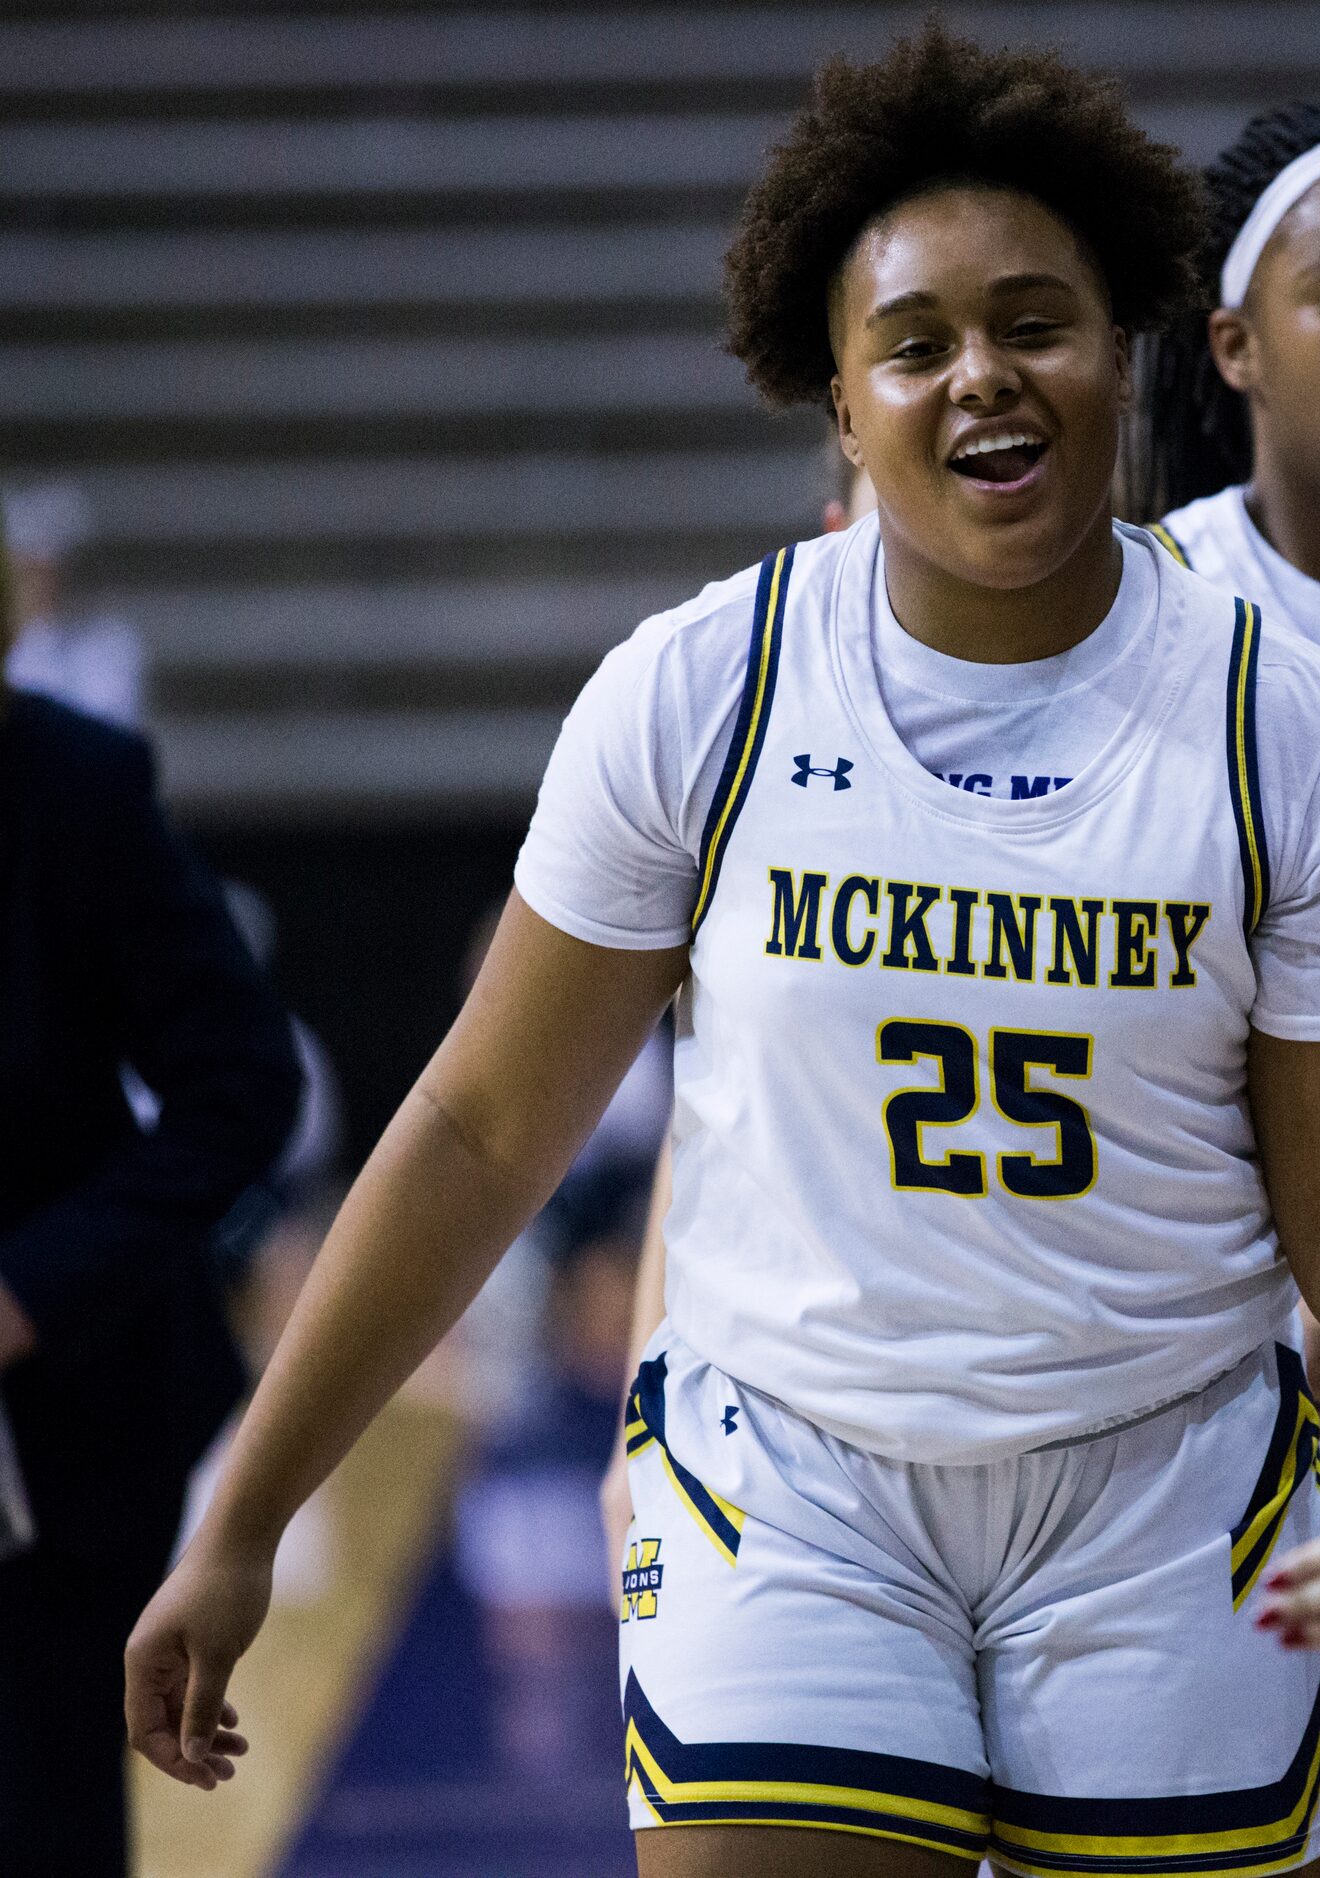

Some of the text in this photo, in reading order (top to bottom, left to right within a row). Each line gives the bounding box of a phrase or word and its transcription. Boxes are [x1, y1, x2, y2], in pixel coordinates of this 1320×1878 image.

[763, 865, 1212, 989] MCKINNEY
[875, 1016, 1100, 1200] 25
[624, 1569, 659, 1589] IONS
